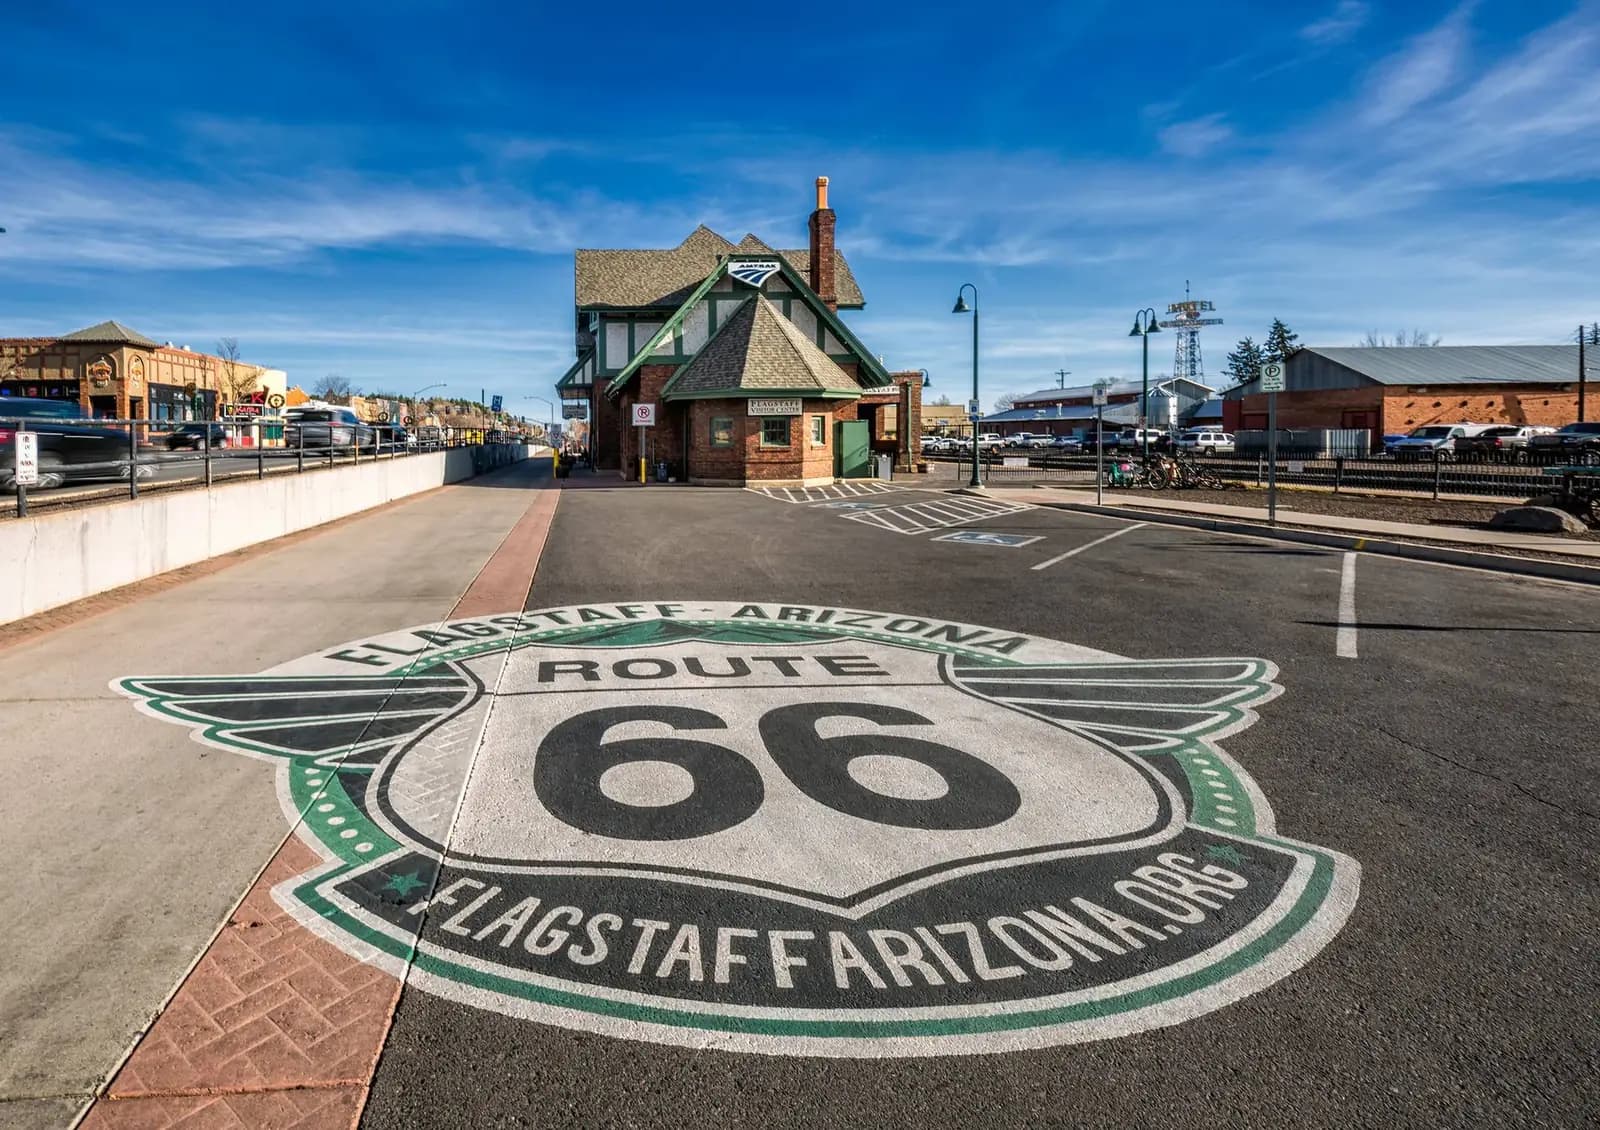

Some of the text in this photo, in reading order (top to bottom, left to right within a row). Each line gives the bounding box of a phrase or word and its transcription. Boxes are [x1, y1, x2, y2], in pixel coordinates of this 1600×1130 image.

[326, 603, 1029, 667] FLAGSTAFF ARIZONA
[536, 654, 891, 684] ROUTE
[533, 701, 1022, 842] 66
